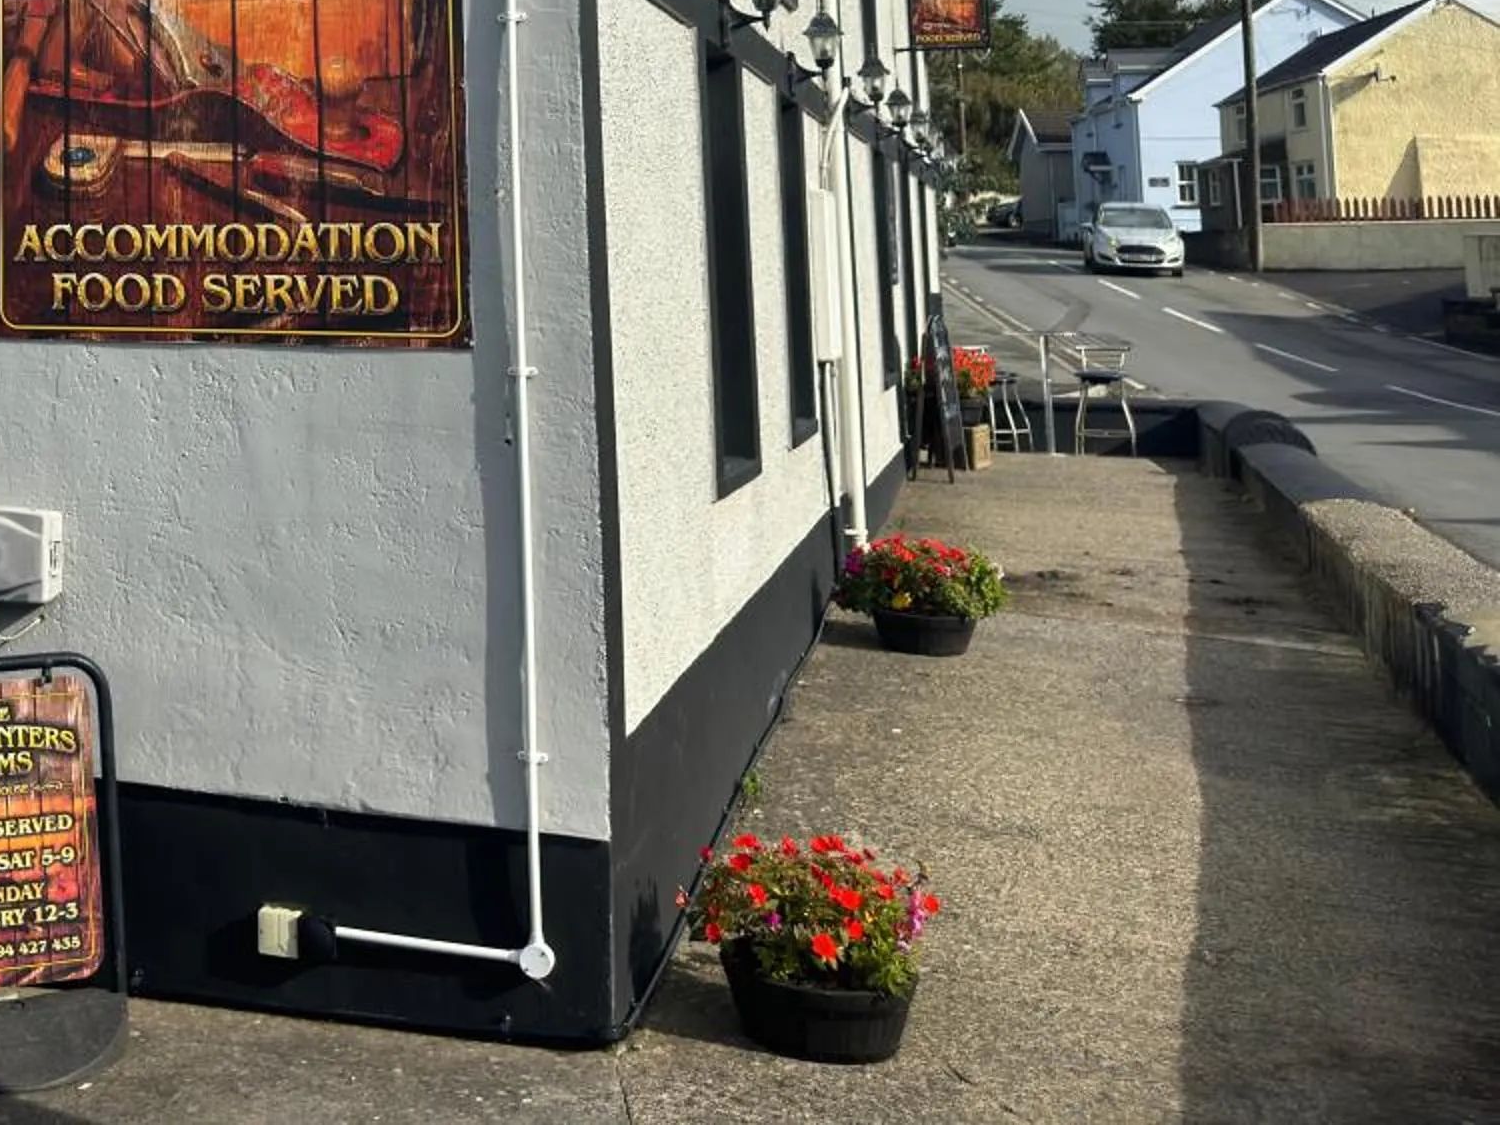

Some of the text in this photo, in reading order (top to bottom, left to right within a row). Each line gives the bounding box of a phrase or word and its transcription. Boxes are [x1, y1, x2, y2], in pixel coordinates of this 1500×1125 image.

[12, 220, 446, 265] ACCOMMODATION
[51, 272, 400, 316] FOOD SERVED
[32, 902, 79, 923] 12-3
[19, 940, 47, 955] 427
